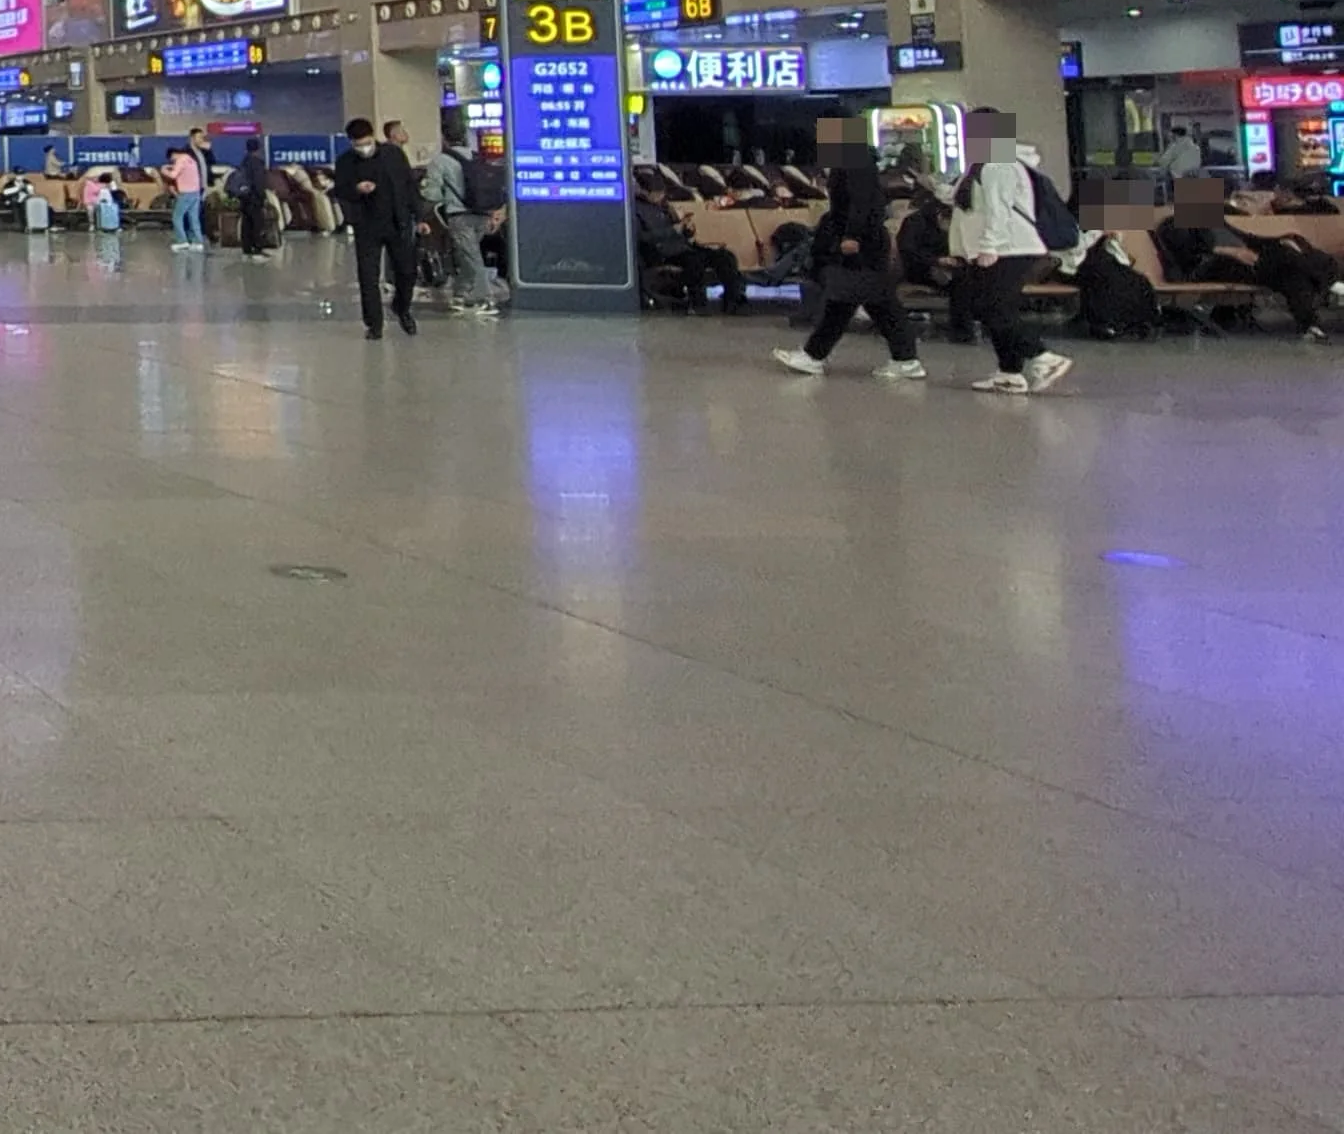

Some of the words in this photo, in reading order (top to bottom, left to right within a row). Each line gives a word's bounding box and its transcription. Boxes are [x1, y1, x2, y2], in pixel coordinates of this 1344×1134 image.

[528, 4, 594, 43] 3B
[534, 62, 588, 76] G2652
[686, 49, 799, 89] 便利店
